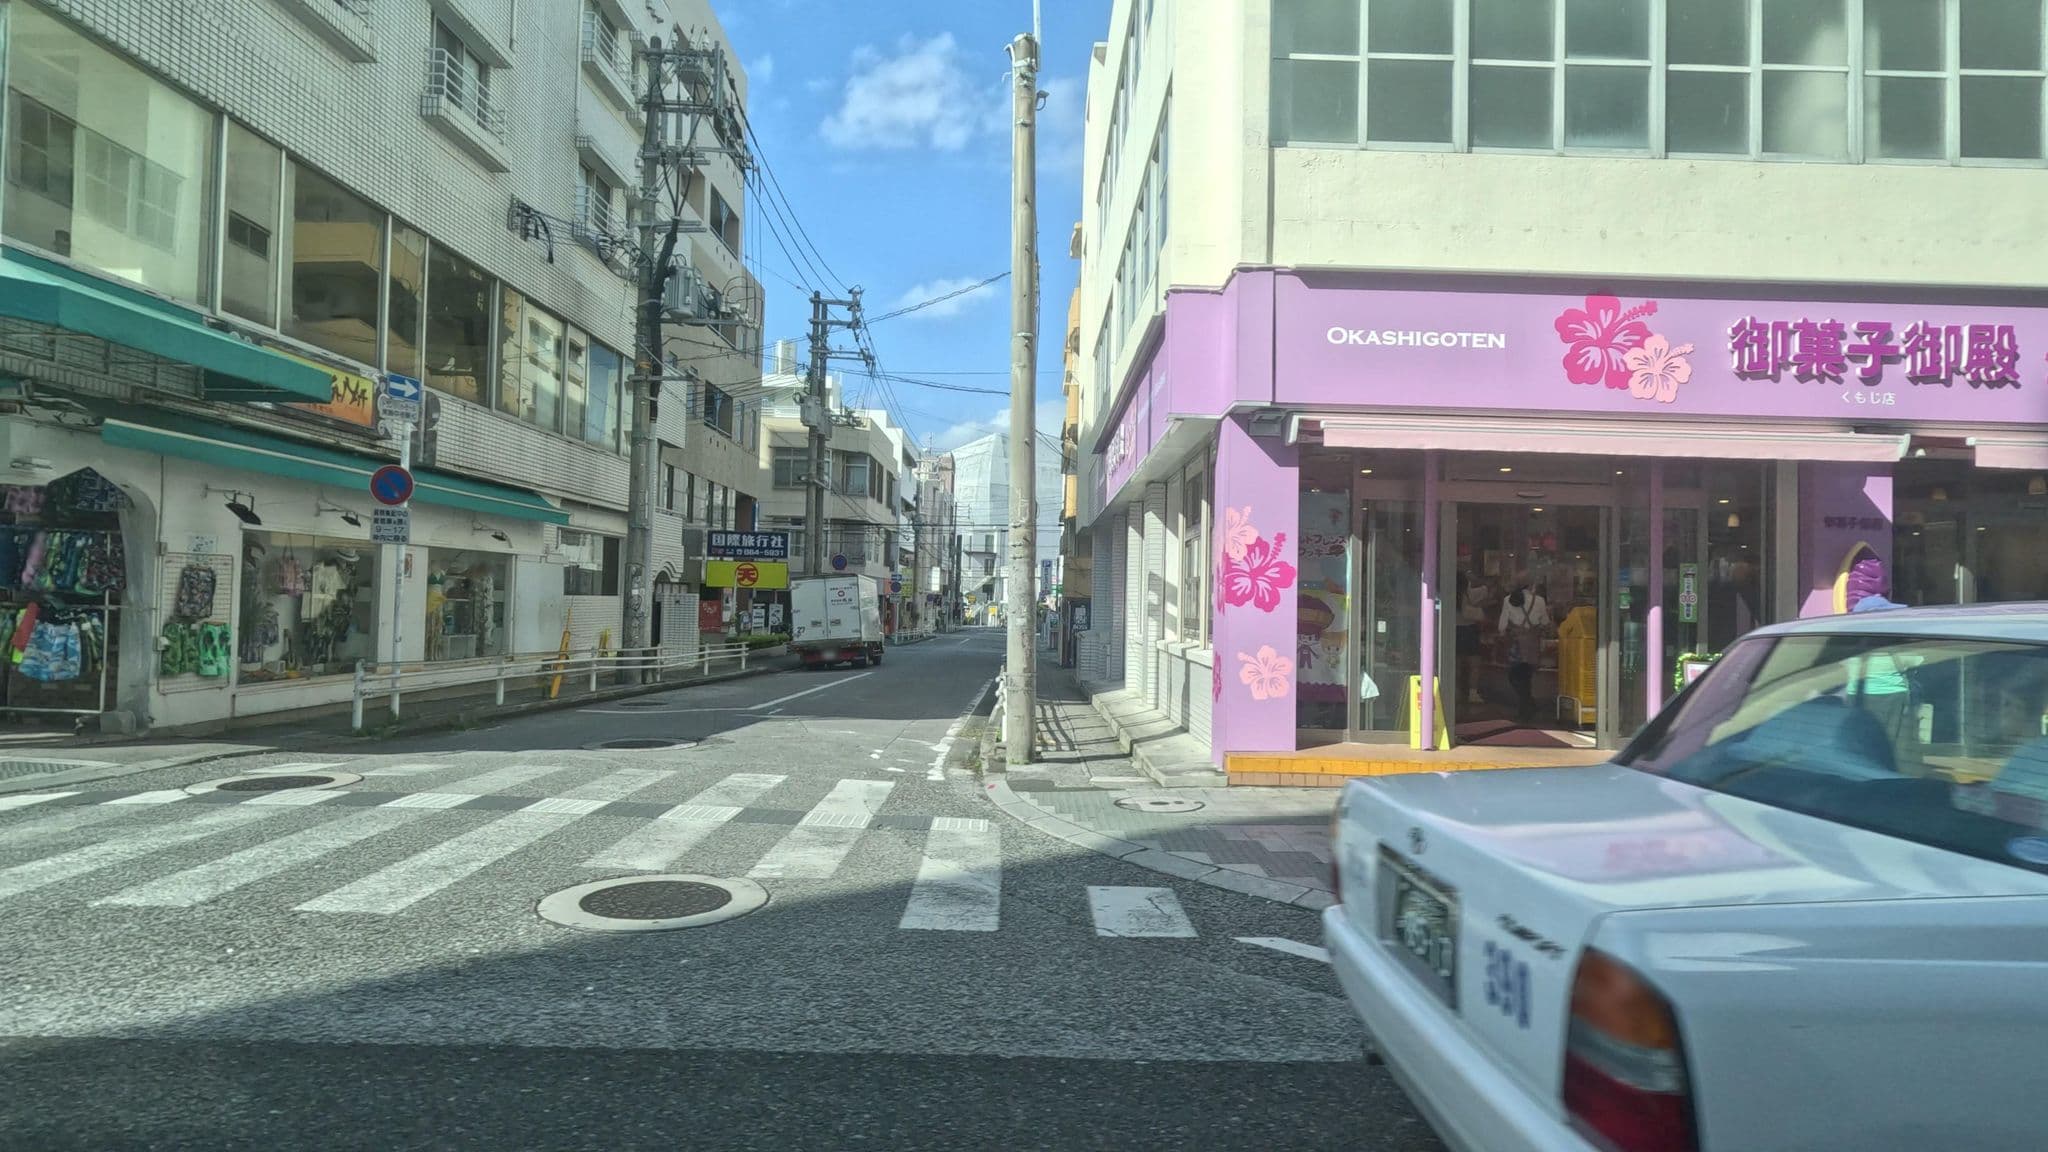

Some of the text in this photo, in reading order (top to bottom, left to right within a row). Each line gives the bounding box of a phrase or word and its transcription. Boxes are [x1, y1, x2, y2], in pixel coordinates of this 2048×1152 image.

[1327, 327, 1506, 349] OKASHIGOTEN
[1728, 316, 2020, 387] 御菓子御殿
[1842, 391, 1896, 406] くもじ店
[712, 533, 785, 549] 国際旅行社
